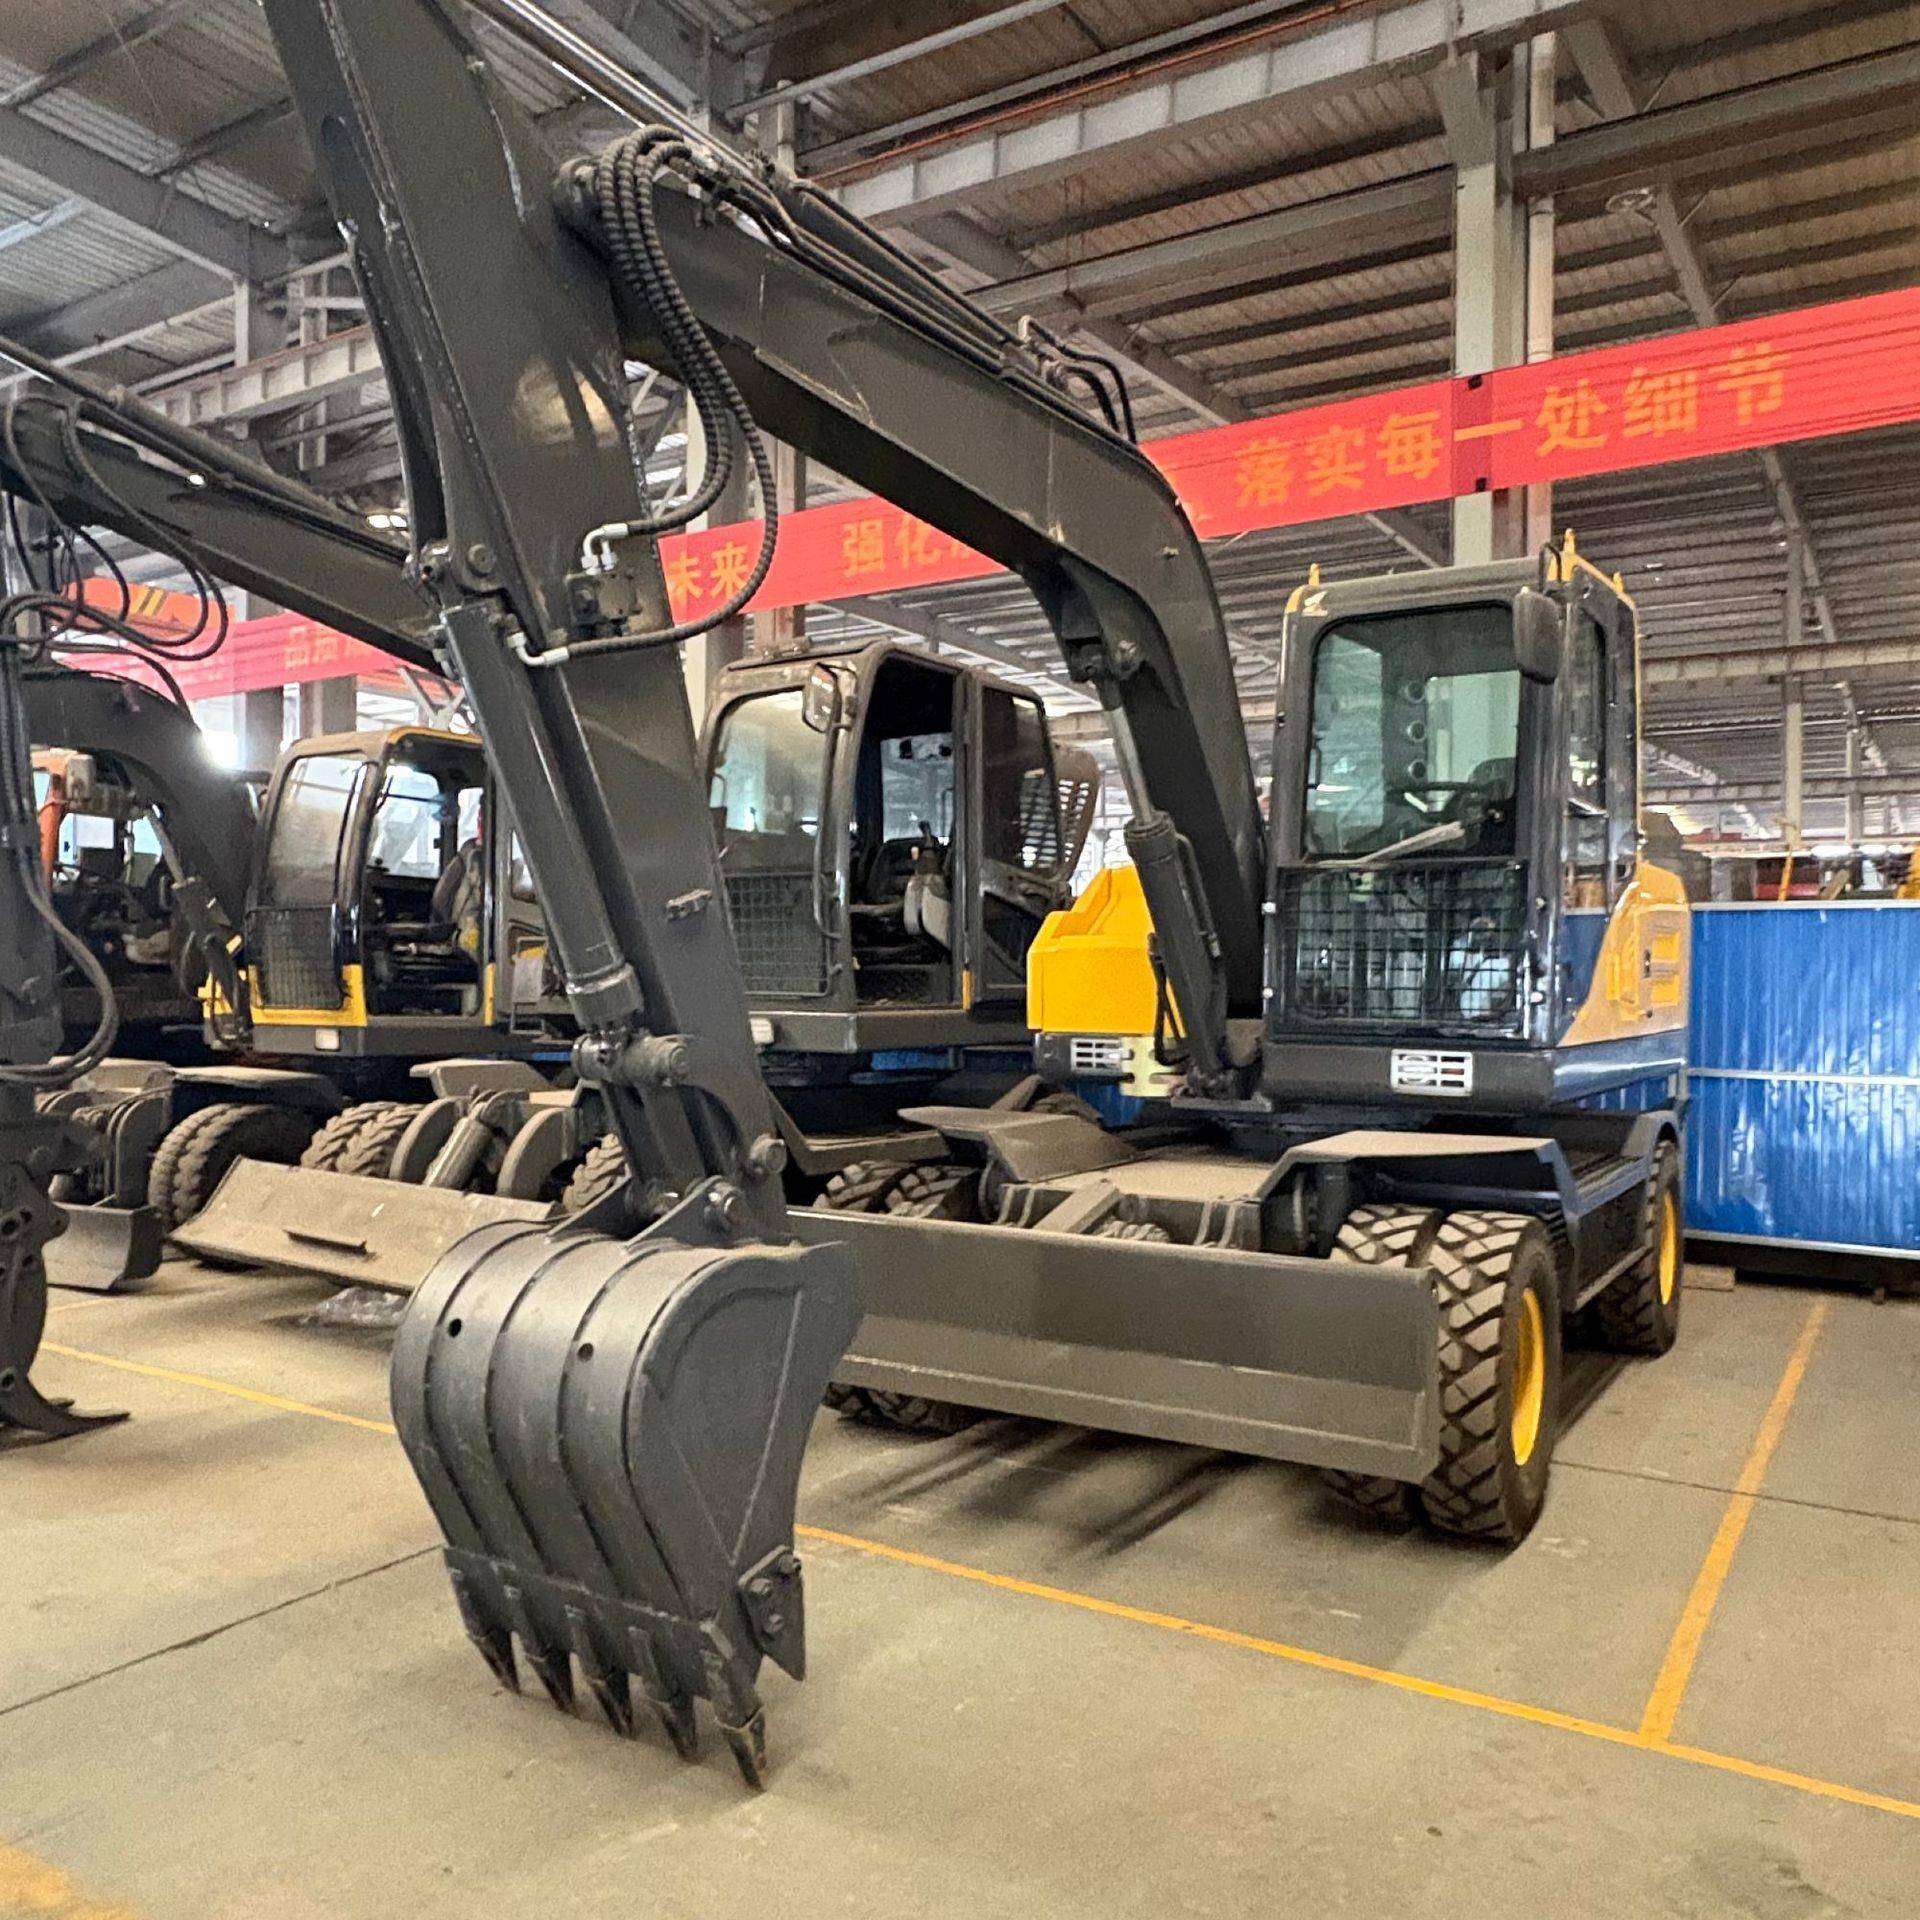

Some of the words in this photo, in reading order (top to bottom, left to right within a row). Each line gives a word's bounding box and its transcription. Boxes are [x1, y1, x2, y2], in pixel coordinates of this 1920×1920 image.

[665, 541, 749, 606] 未来
[843, 514, 971, 578] 强化
[1163, 342, 1792, 521] 落实每一处细节
